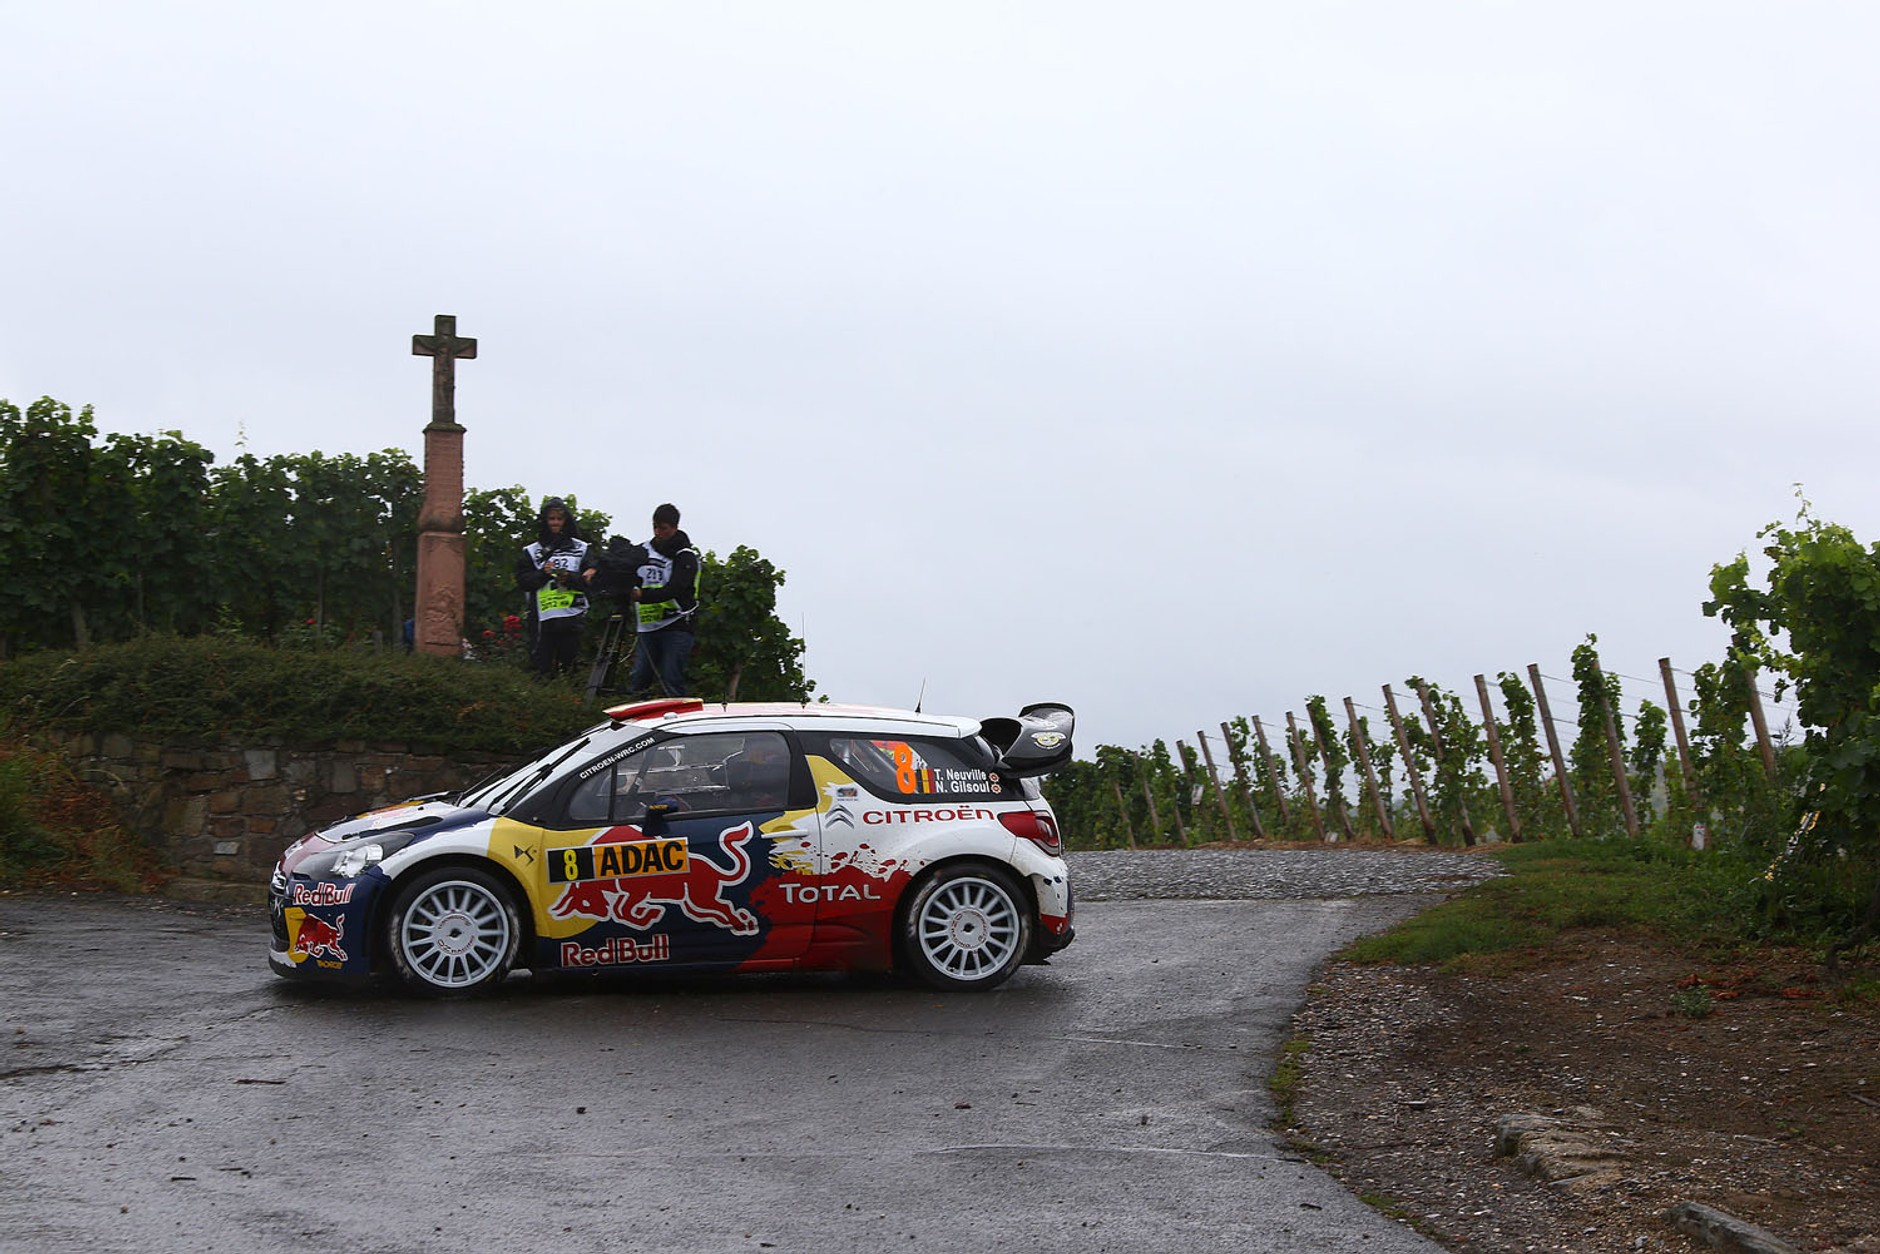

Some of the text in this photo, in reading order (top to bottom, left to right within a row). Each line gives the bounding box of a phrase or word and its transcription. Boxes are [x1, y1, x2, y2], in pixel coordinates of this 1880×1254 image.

[579, 736, 656, 780] CITROEN-WRC.COM
[893, 743, 917, 794] 8
[934, 769, 987, 781] T. Neuville
[935, 781, 990, 793] N. Gilsoul
[563, 841, 684, 881] 8 ADAC
